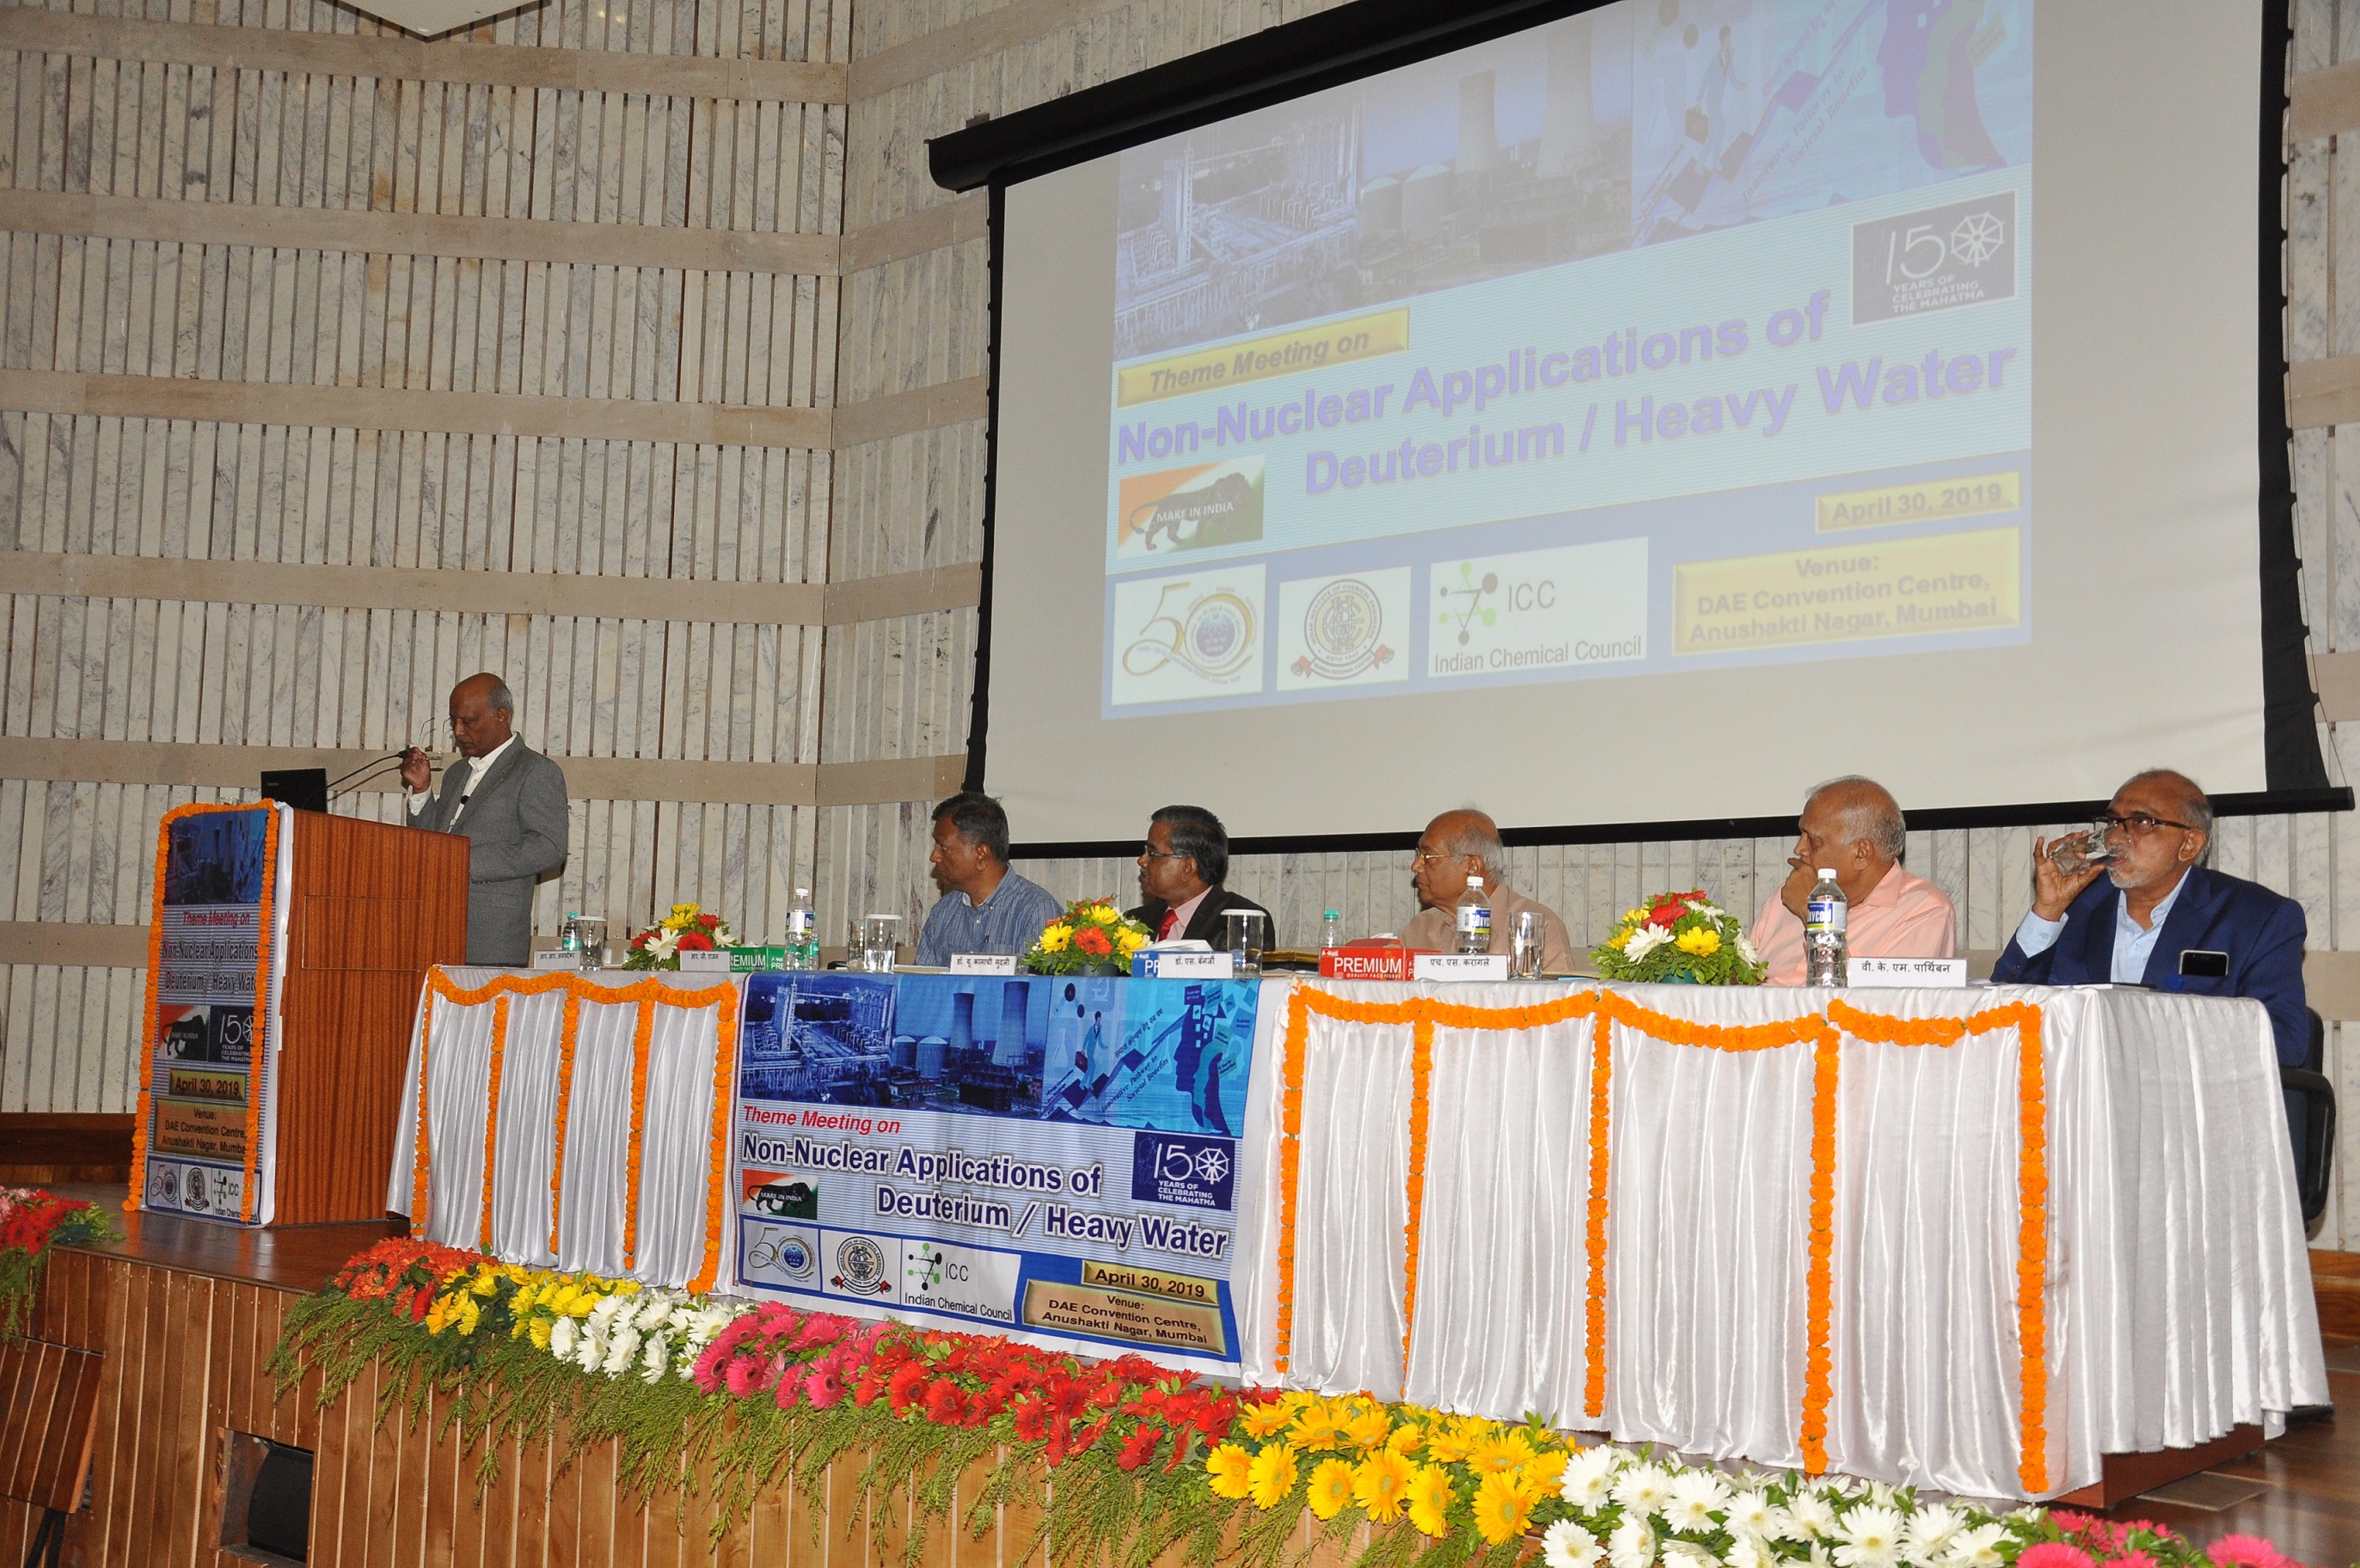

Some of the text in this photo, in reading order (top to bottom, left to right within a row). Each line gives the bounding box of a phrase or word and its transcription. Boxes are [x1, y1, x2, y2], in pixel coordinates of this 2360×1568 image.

[1827, 66, 1868, 119] Benefits
[1892, 280, 1979, 304] CELEBRATING
[1893, 274, 1955, 292] YEARS OF
[1892, 290, 1985, 314] THE MAHATMA
[1149, 331, 1370, 393] Theme Meeting on
[1118, 289, 1832, 464] Non-Nuclear Applications of
[1305, 346, 2018, 495] Deuterium / Heavy Water
[1156, 502, 1234, 523] MAKE IN INDIA
[1831, 482, 2002, 526] April 30, 2019
[1794, 555, 1879, 580] Venue:
[1508, 579, 1555, 612] ICC
[1697, 573, 1990, 616] DAE Convention Centre,
[1689, 597, 1997, 643] Anushakti Nagar, Mumbai
[1435, 635, 1641, 673] Indian Chemical Council
[183, 910, 250, 928] Theme Meeting on
[162, 940, 259, 965] Non-Nuclear Applications
[1333, 957, 1402, 973] PREMIUM
[1861, 960, 1874, 972] वी.
[1877, 960, 1889, 972] के.
[1892, 963, 1910, 972] एम.
[165, 971, 205, 990] Deuterium
[213, 971, 236, 995] Heavy
[175, 1077, 240, 1096] April 30, 2019
[1101, 1084, 1129, 1113] Innovative
[1130, 1063, 1150, 1086] Pathway
[1127, 1058, 1168, 1102] Societal Benefits
[193, 1108, 217, 1120] Venue:
[744, 1106, 901, 1135] Theme Meeting on
[165, 1120, 247, 1141] DAE Convention Centre,
[162, 1136, 246, 1155] Anushakti Nagar, Mumba
[742, 1132, 1101, 1196] Non-Nuclear Applications of
[228, 1183, 239, 1197] ICC
[1158, 1179, 1185, 1190] YEARS
[1158, 1187, 1213, 1199] CELEBRATING
[1158, 1193, 1216, 1207] THE MAHATMA
[878, 1186, 1229, 1258] Deuterium / Heavy Water
[945, 1263, 969, 1282] ICC
[1094, 1269, 1205, 1297] April 30, 2019
[905, 1292, 1013, 1321] Indian Chemical Council
[1106, 1295, 1144, 1310] Venue:
[1042, 1311, 1207, 1344] Anushakti Nagar, Mumbai
[1049, 1299, 1201, 1332] DAE Convention Centre,
